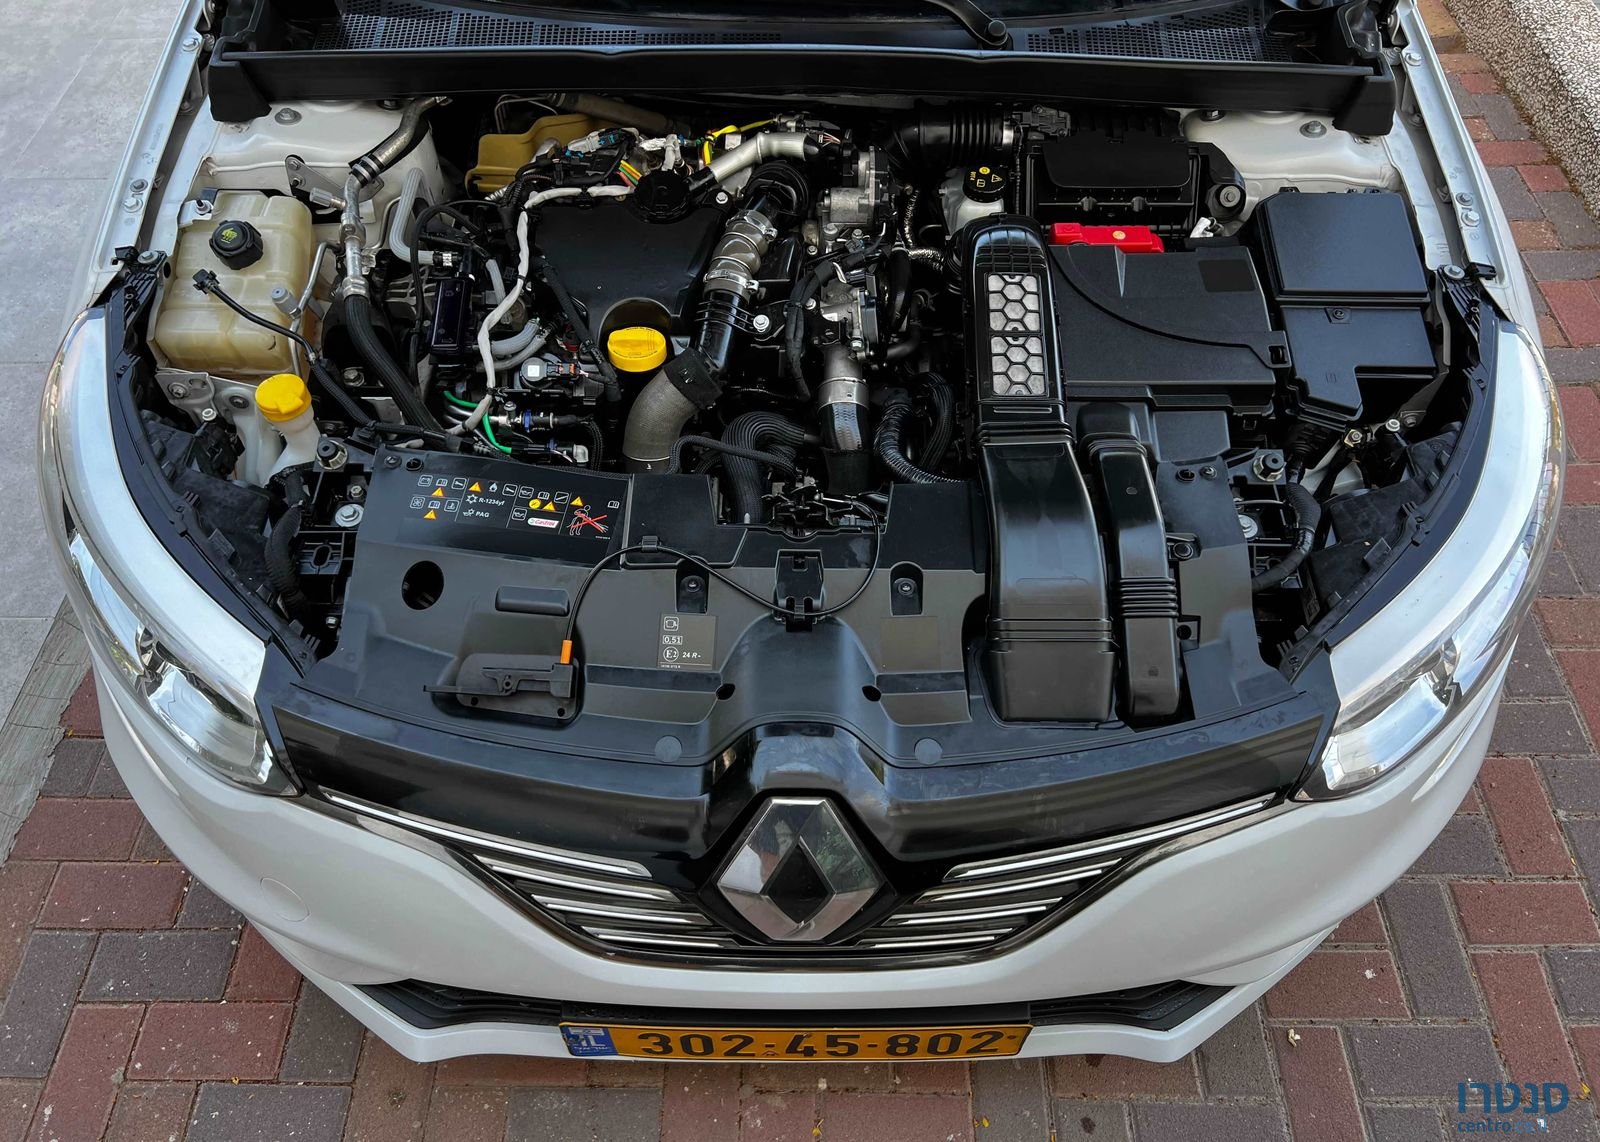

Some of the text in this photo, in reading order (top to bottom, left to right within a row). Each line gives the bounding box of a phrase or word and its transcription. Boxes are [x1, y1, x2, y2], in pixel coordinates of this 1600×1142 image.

[478, 497, 506, 507] R-1234yf
[475, 510, 490, 518] PAG
[534, 518, 556, 527] Castrol
[682, 651, 691, 659] 24
[637, 1030, 1004, 1058] 302-45-802
